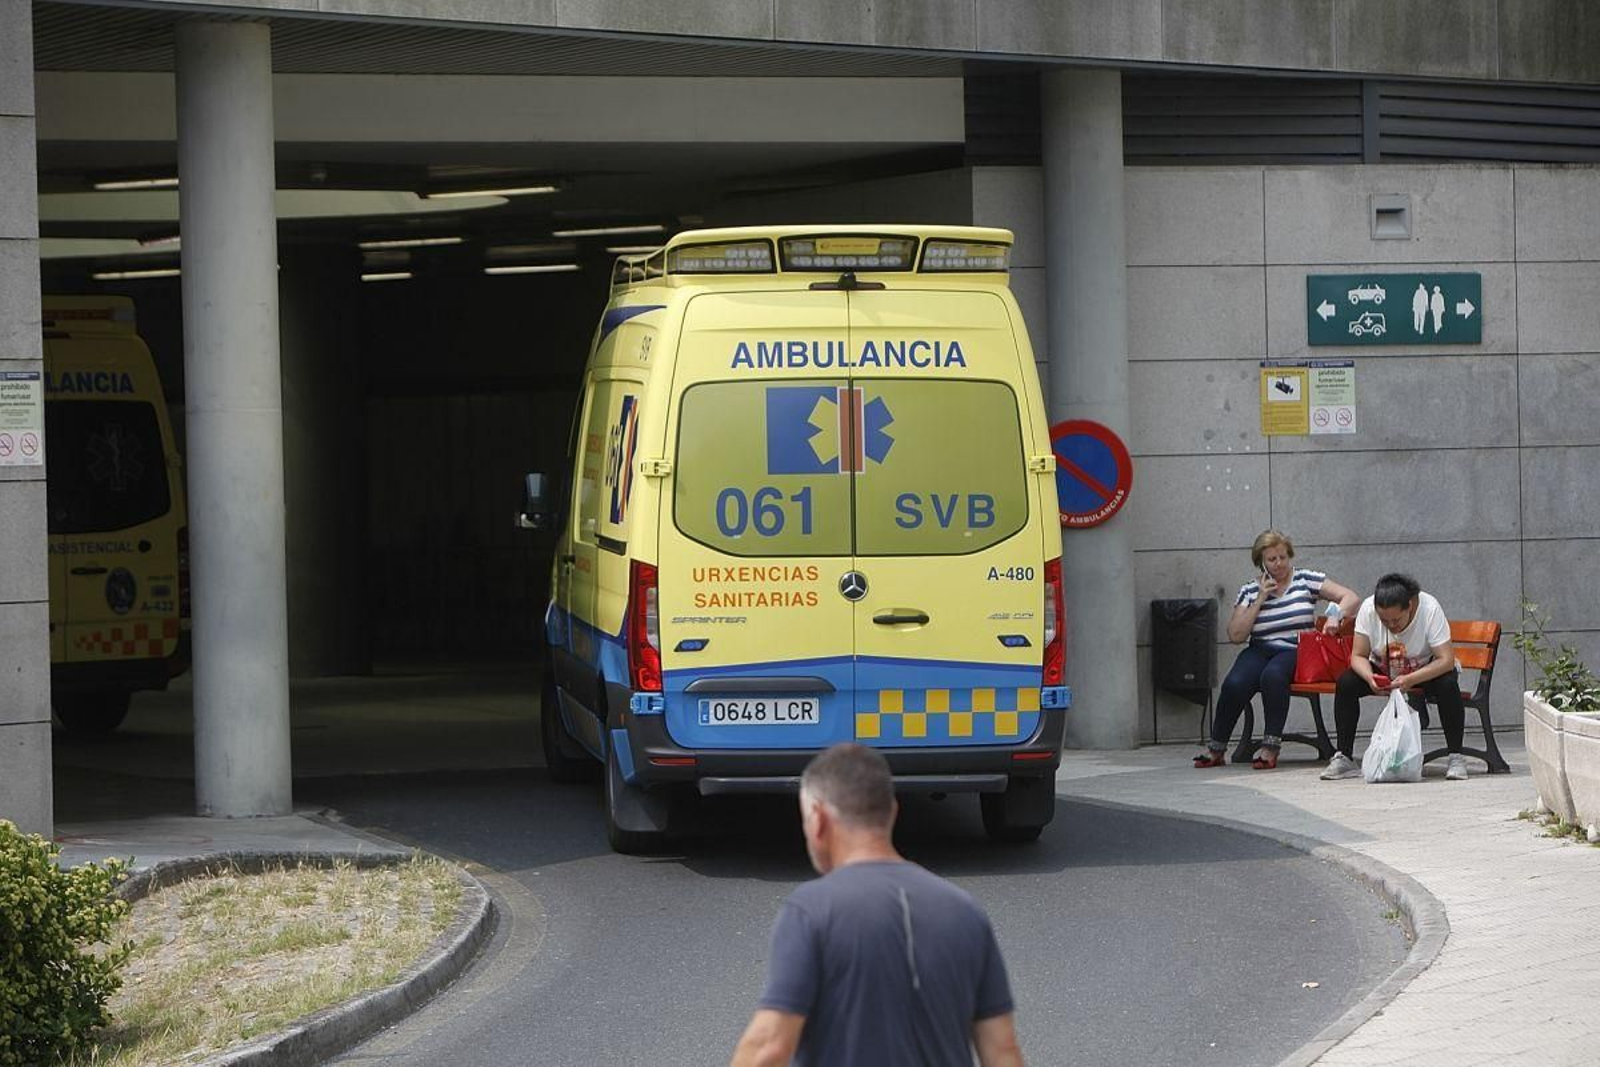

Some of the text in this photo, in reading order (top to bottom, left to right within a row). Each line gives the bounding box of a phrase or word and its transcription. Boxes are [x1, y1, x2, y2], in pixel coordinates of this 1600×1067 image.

[731, 340, 966, 369] AMBULANCIA
[715, 486, 813, 538] 061
[894, 493, 996, 529] SVB
[692, 565, 819, 583] URXENCIAS
[987, 567, 1034, 581] A-480
[694, 591, 819, 608] SANITARIAS
[671, 616, 748, 624] SPRINTER
[714, 702, 766, 721] 0648
[774, 701, 813, 721] LCR
